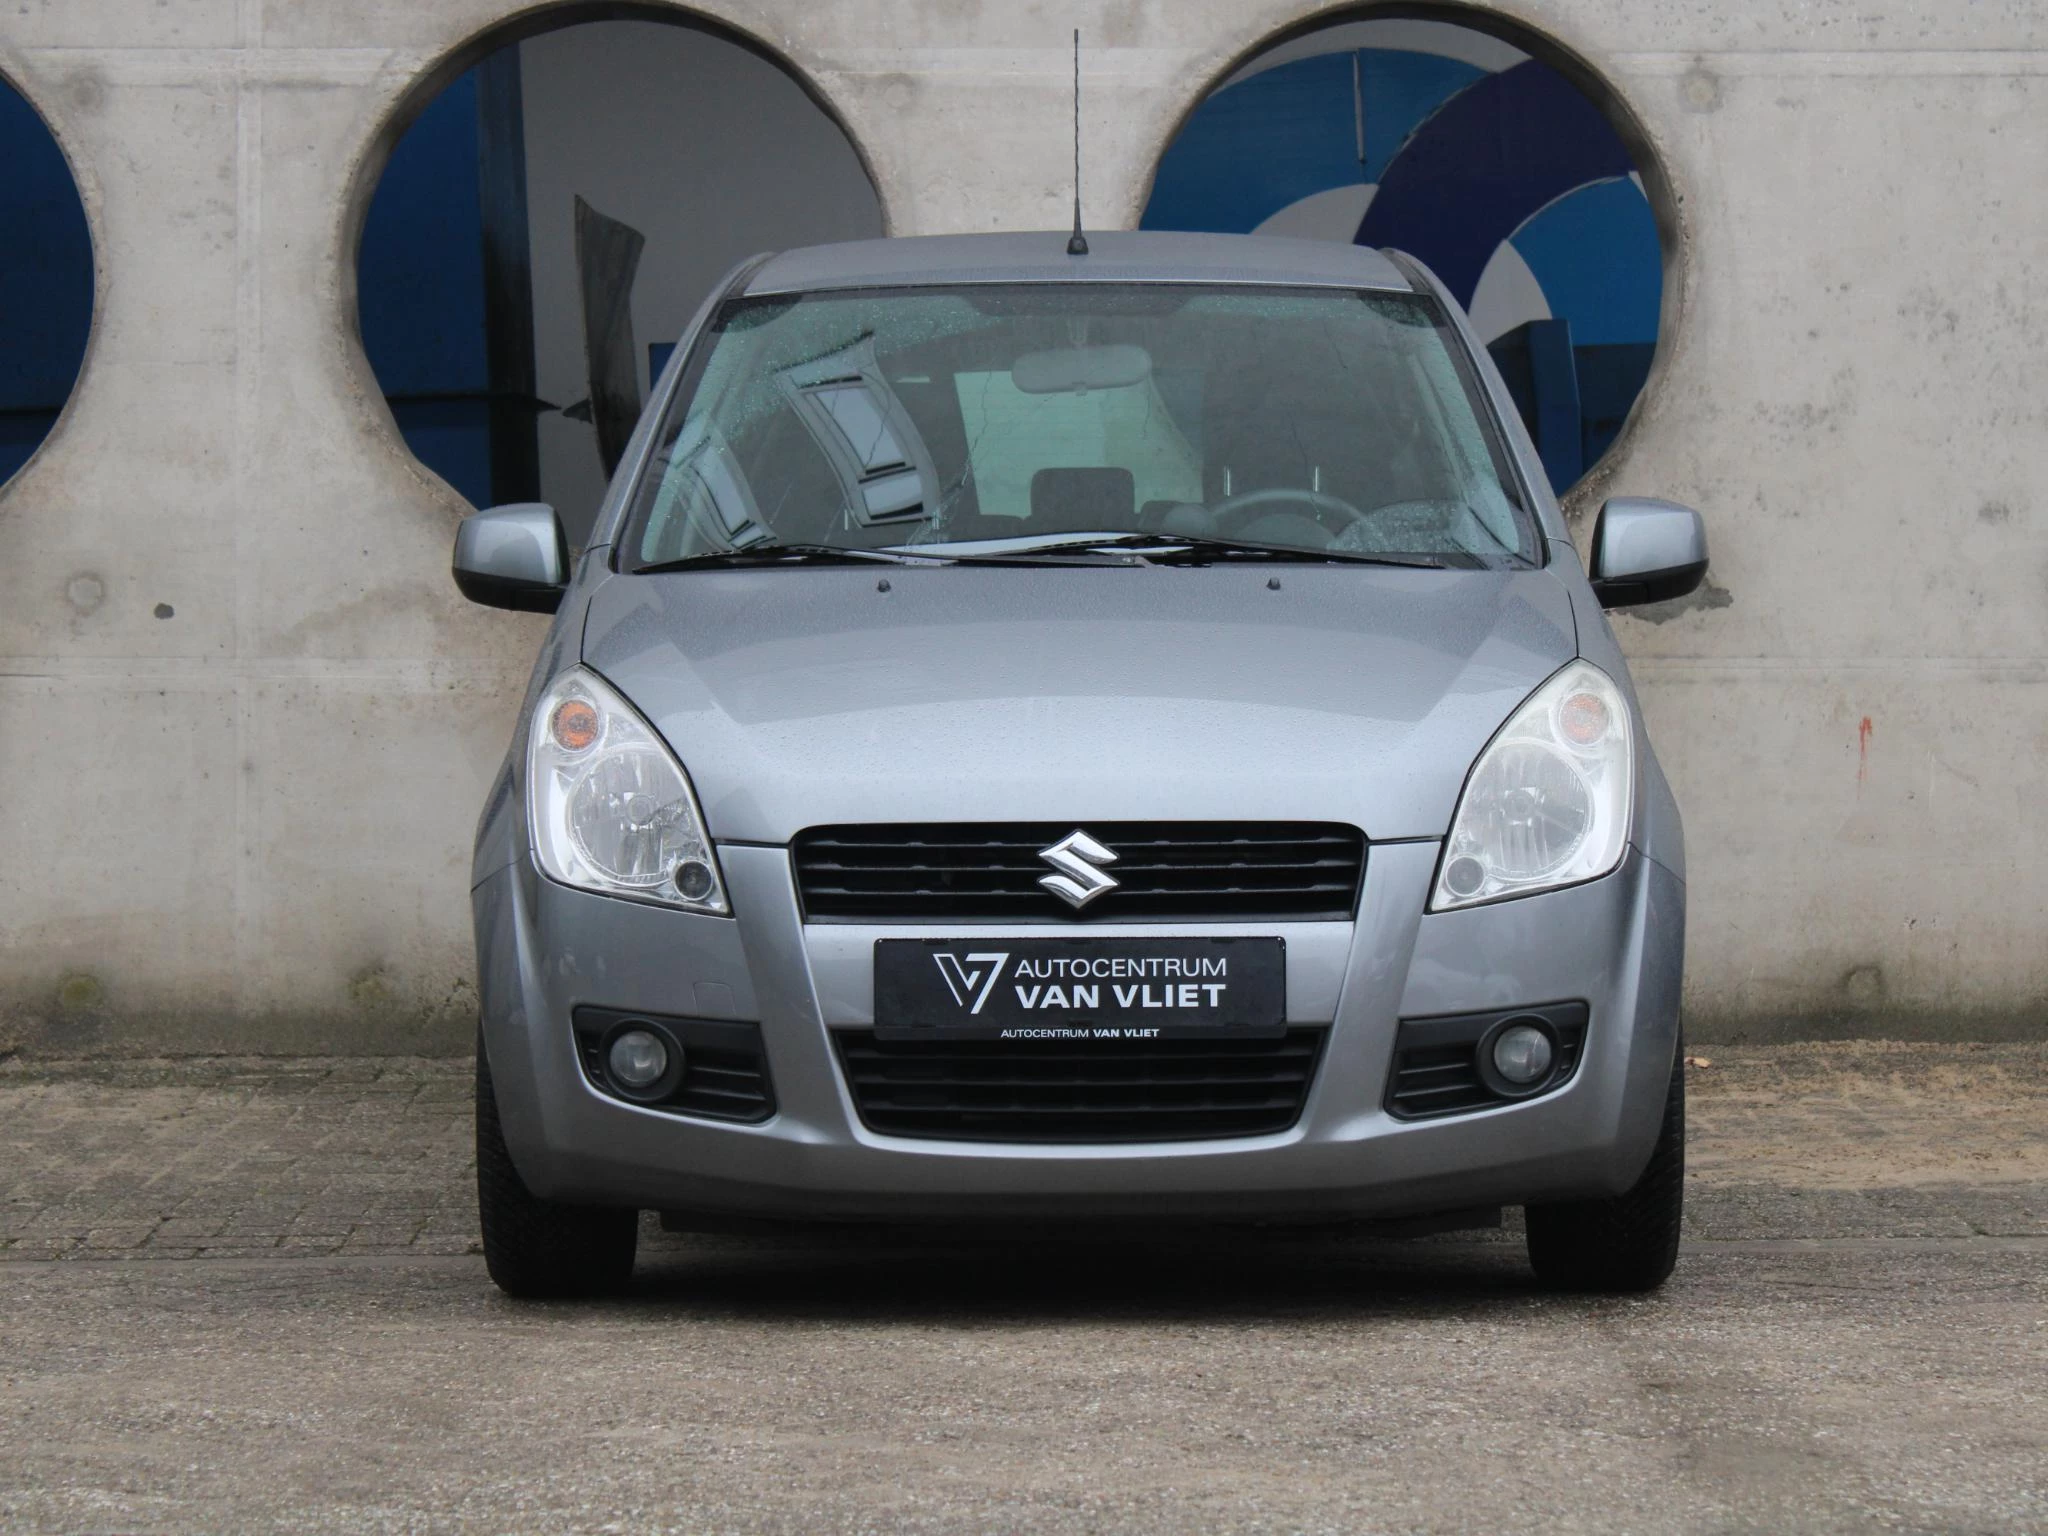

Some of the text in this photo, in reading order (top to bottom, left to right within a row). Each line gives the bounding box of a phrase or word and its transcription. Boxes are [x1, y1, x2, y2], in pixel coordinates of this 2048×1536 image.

[1014, 957, 1228, 979] AUTOCENTRUM
[1014, 983, 1228, 1009] VAN VLIET
[1000, 1028, 1161, 1039] AUTOCENTRUM VAN VLIET
